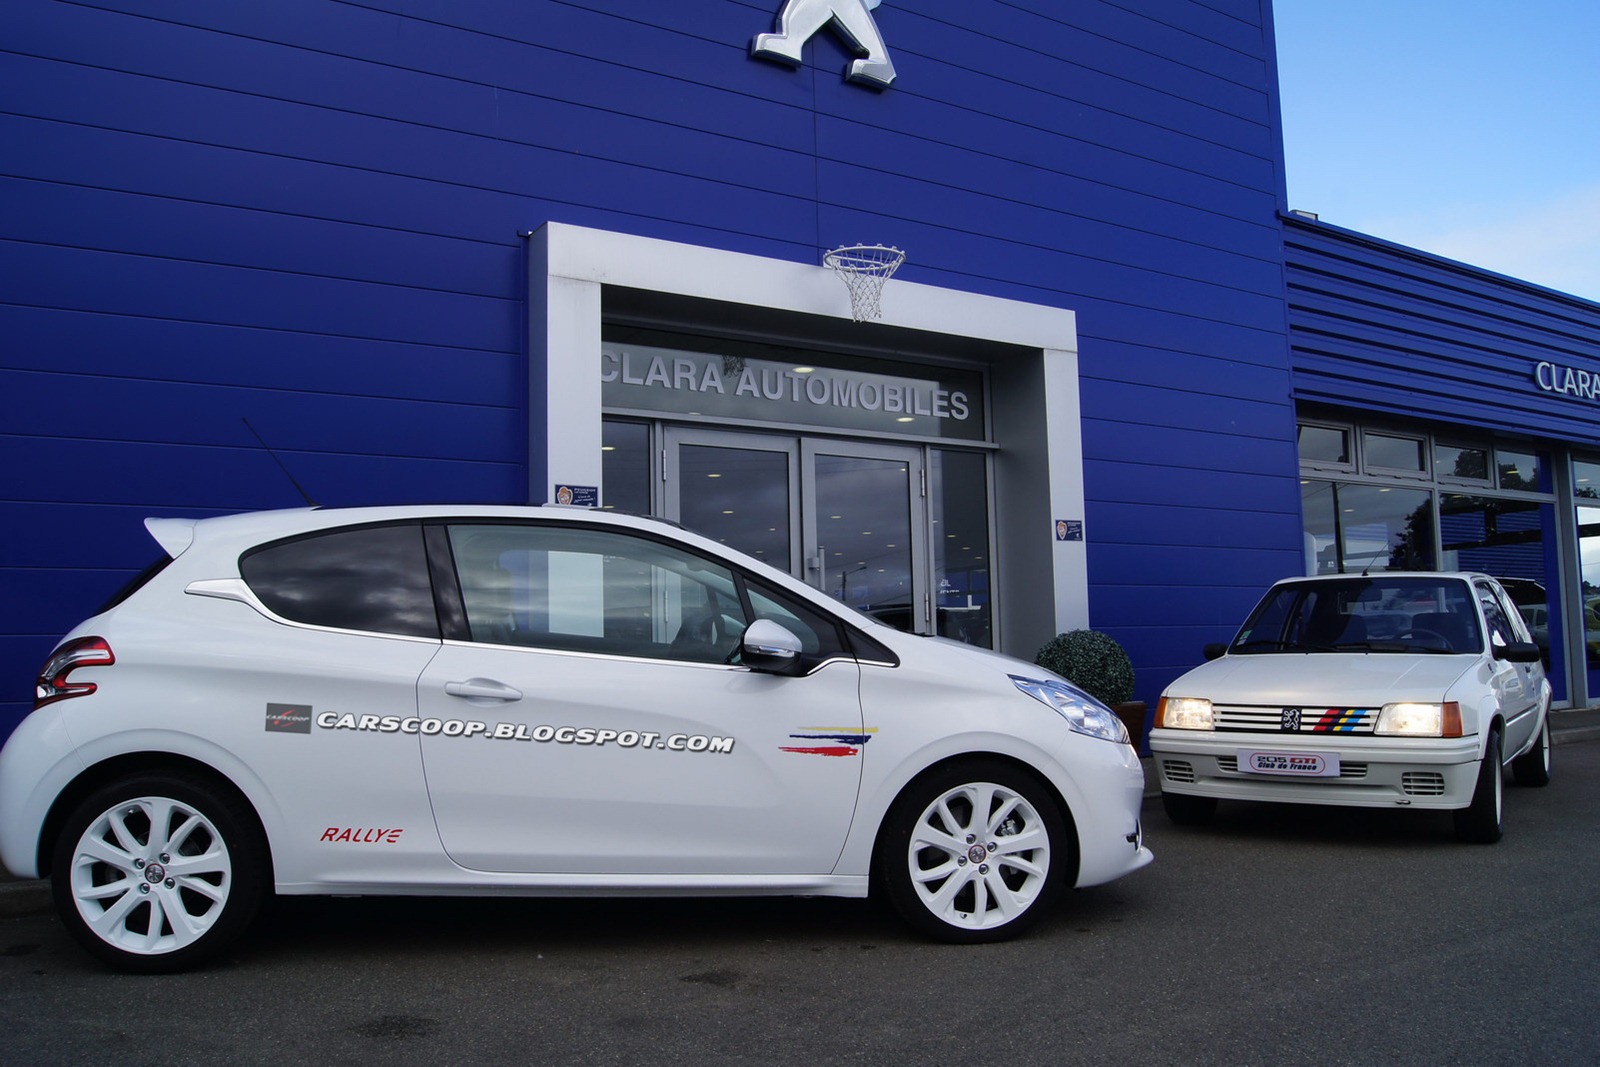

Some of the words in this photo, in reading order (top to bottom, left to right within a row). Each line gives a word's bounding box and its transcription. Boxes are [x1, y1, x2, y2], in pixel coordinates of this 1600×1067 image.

[601, 350, 724, 394] CLARA
[735, 368, 970, 420] AUTOMOBILES
[1536, 361, 1600, 398] CLARA
[317, 711, 735, 753] CARSCOOP.BLOGSPOT.COM
[320, 827, 404, 843] RALLYE
